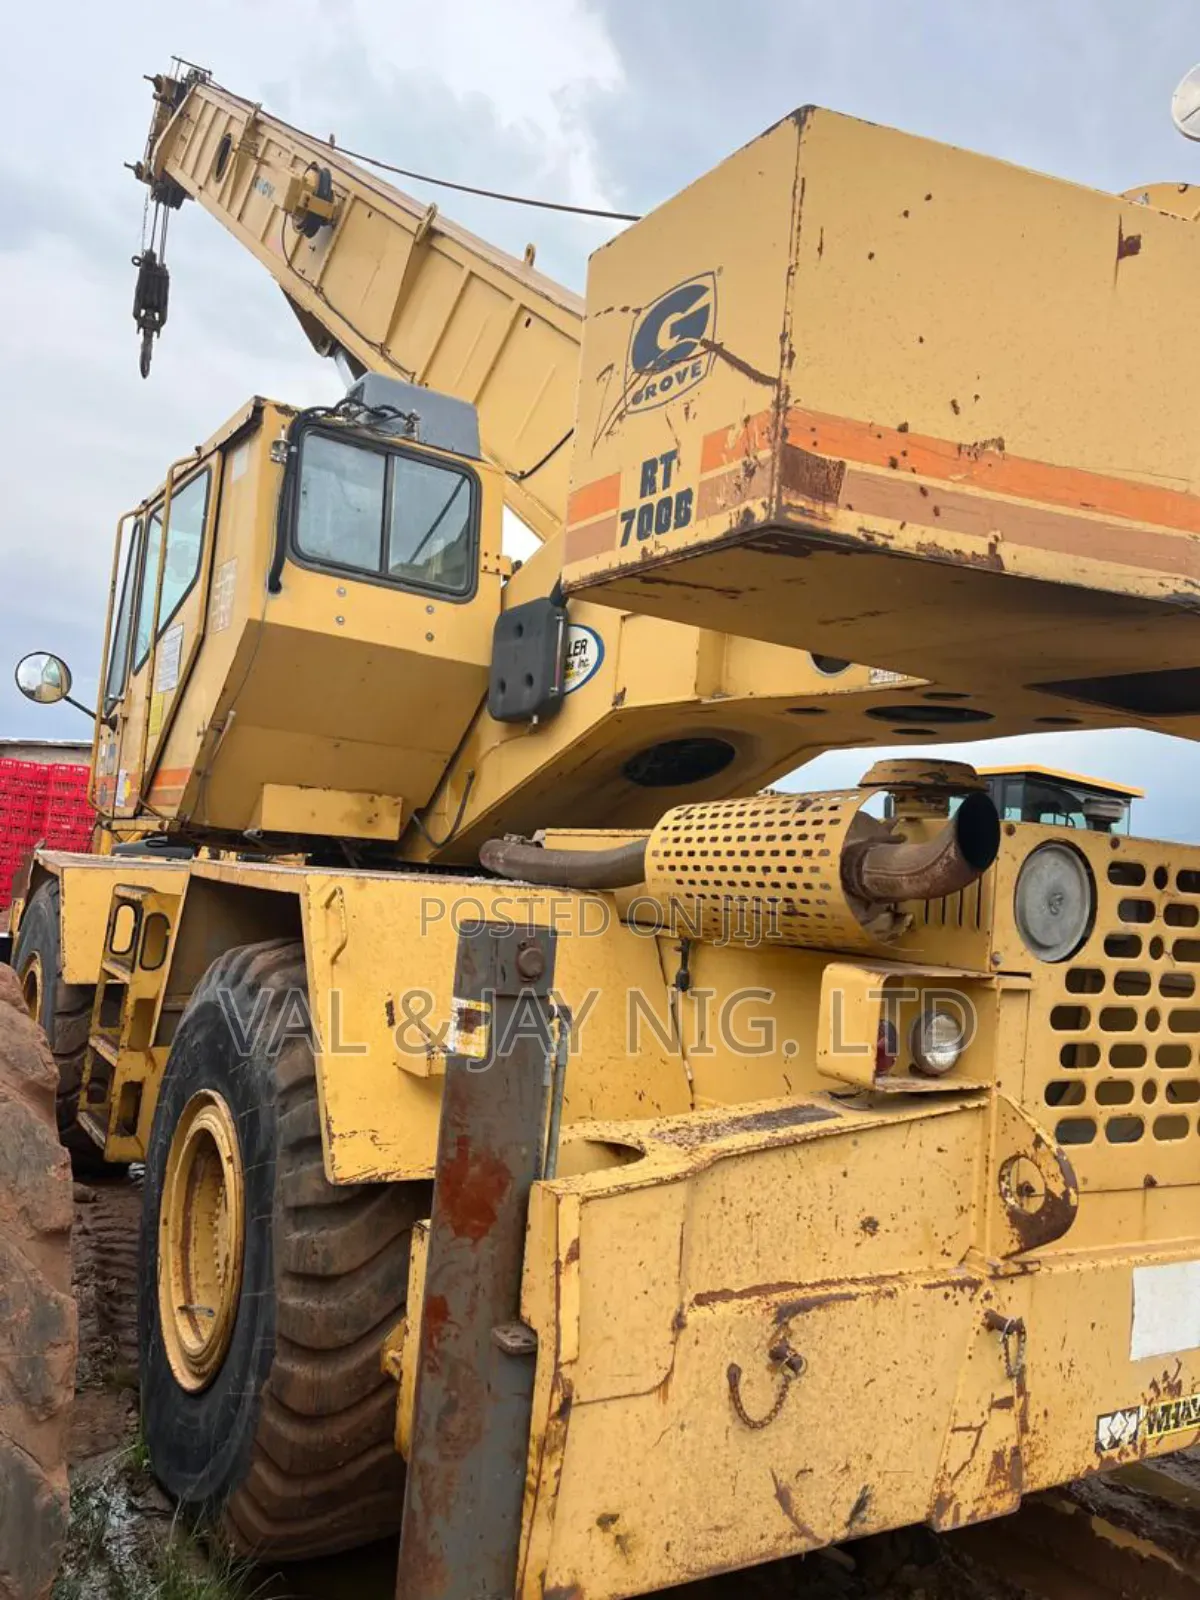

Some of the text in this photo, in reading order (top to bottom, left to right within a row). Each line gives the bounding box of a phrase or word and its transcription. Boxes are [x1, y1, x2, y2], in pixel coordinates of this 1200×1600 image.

[631, 360, 702, 405] GROVE
[640, 448, 677, 499] RT
[620, 487, 693, 548] 700B
